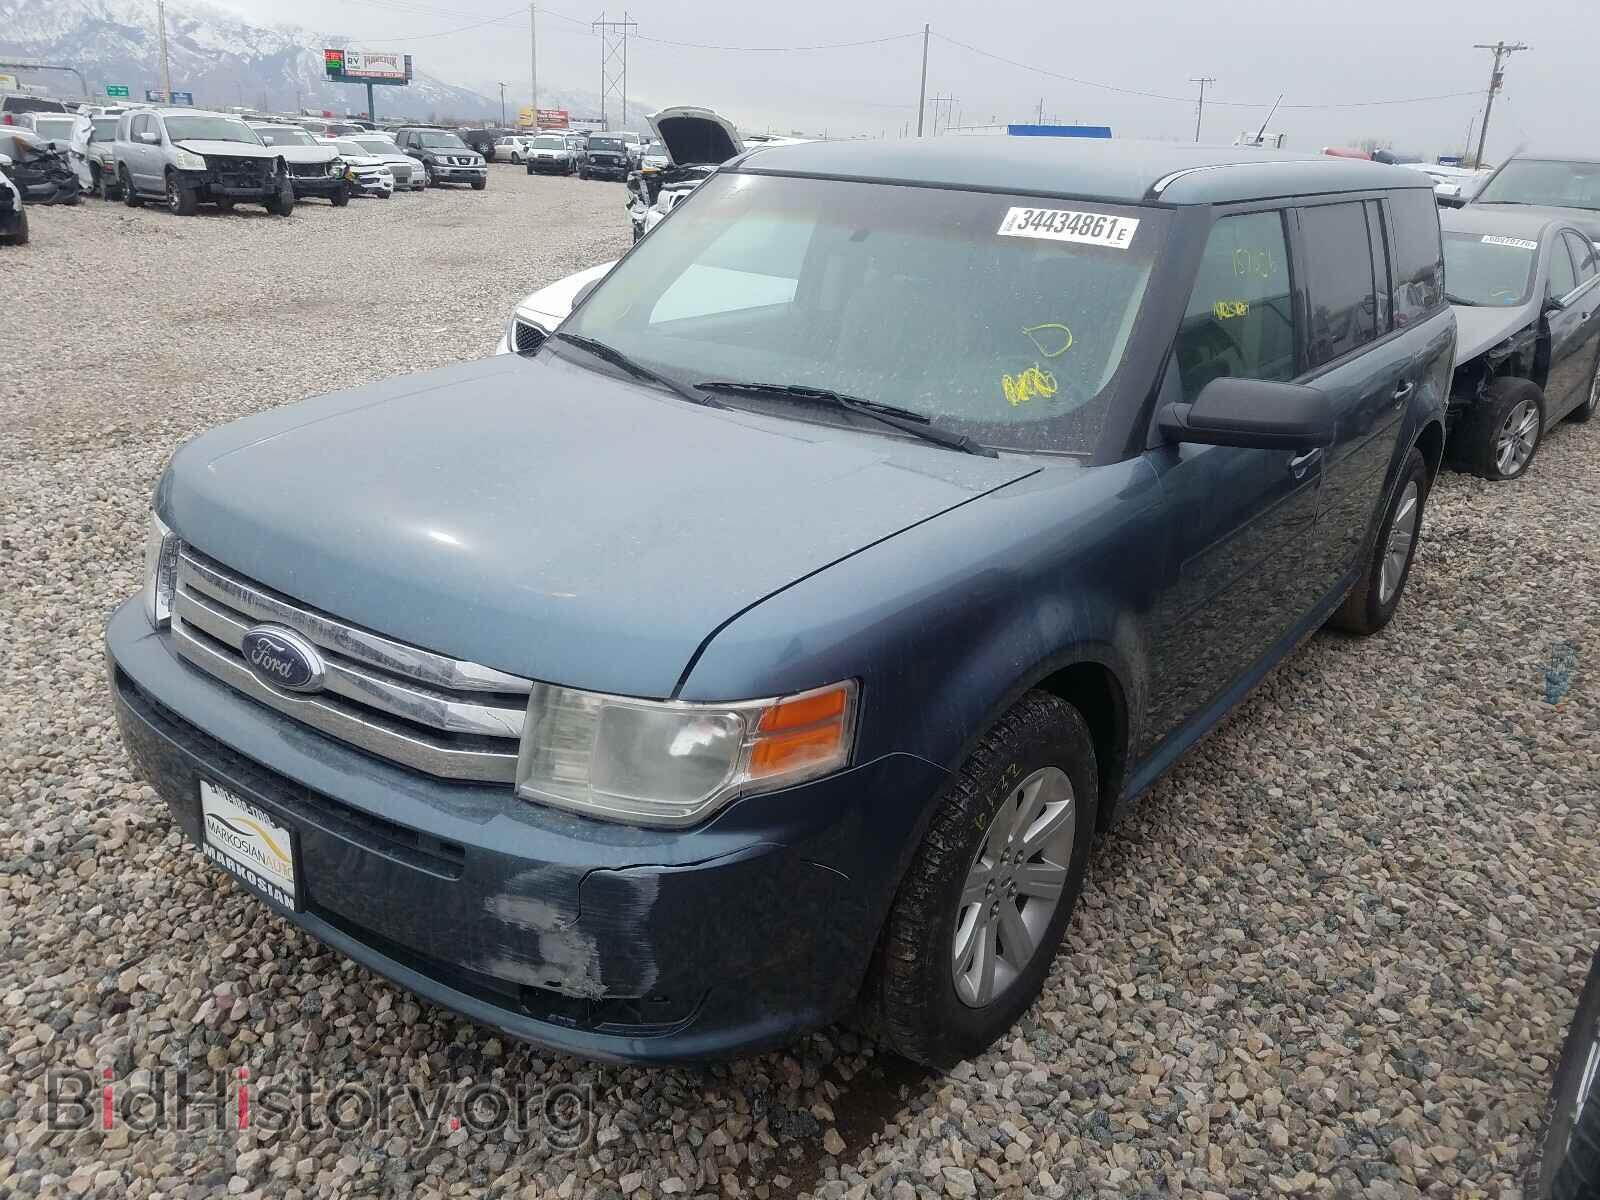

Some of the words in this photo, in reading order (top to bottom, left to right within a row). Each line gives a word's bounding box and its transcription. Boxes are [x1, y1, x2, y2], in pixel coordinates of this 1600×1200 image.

[1017, 209, 1119, 240] 34434861
[251, 637, 295, 679] Ford
[207, 819, 266, 865] MARKOSIAN
[202, 841, 295, 911] MARKOSIAN
